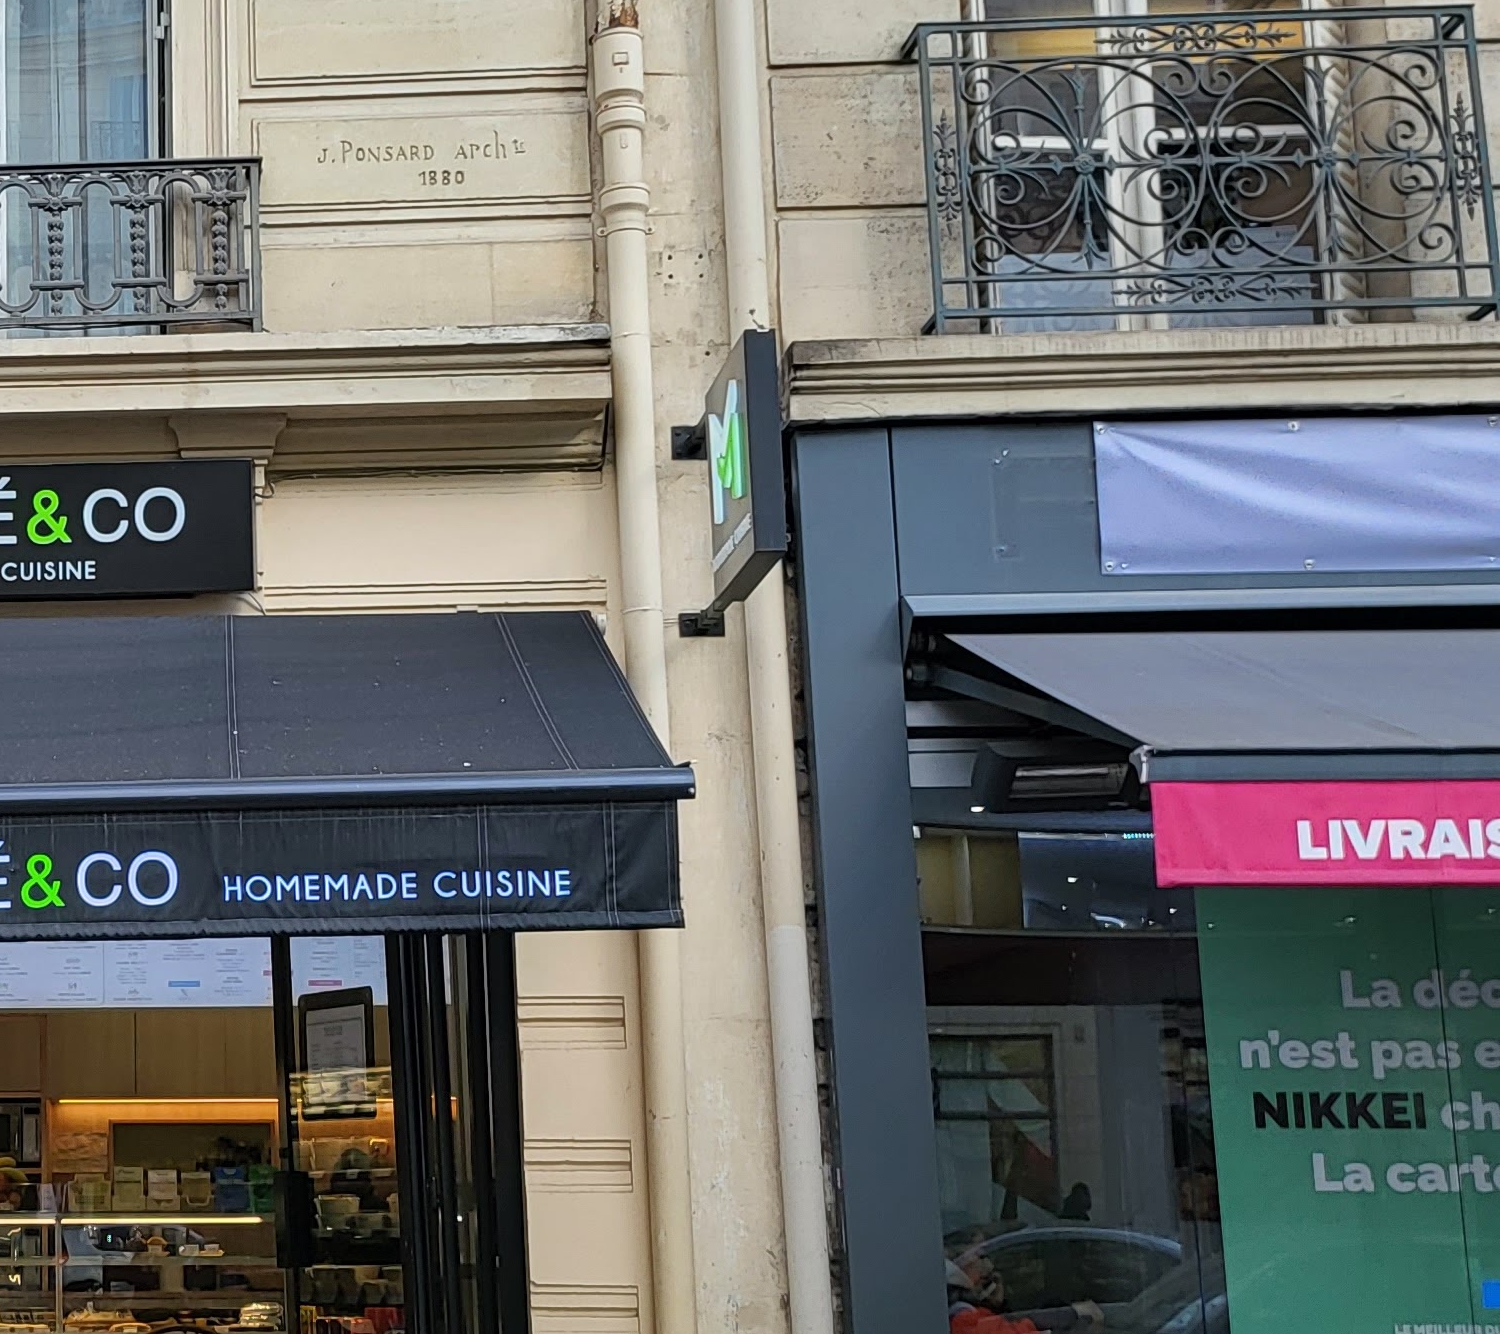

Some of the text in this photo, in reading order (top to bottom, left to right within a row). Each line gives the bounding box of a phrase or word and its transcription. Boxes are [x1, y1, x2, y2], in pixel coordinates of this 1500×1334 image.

[317, 147, 336, 164] J.
[418, 170, 465, 186] 1880
[0, 560, 97, 582] CUISINE
[223, 872, 418, 902] HOMEMADE
[433, 869, 571, 898] CUISINE
[1340, 969, 1402, 1007] La
[1239, 1029, 1359, 1069] n'est
[1370, 1040, 1461, 1080] pas
[1253, 1090, 1500, 1130] NIKKEI ch
[1312, 1152, 1500, 1192] La cart
